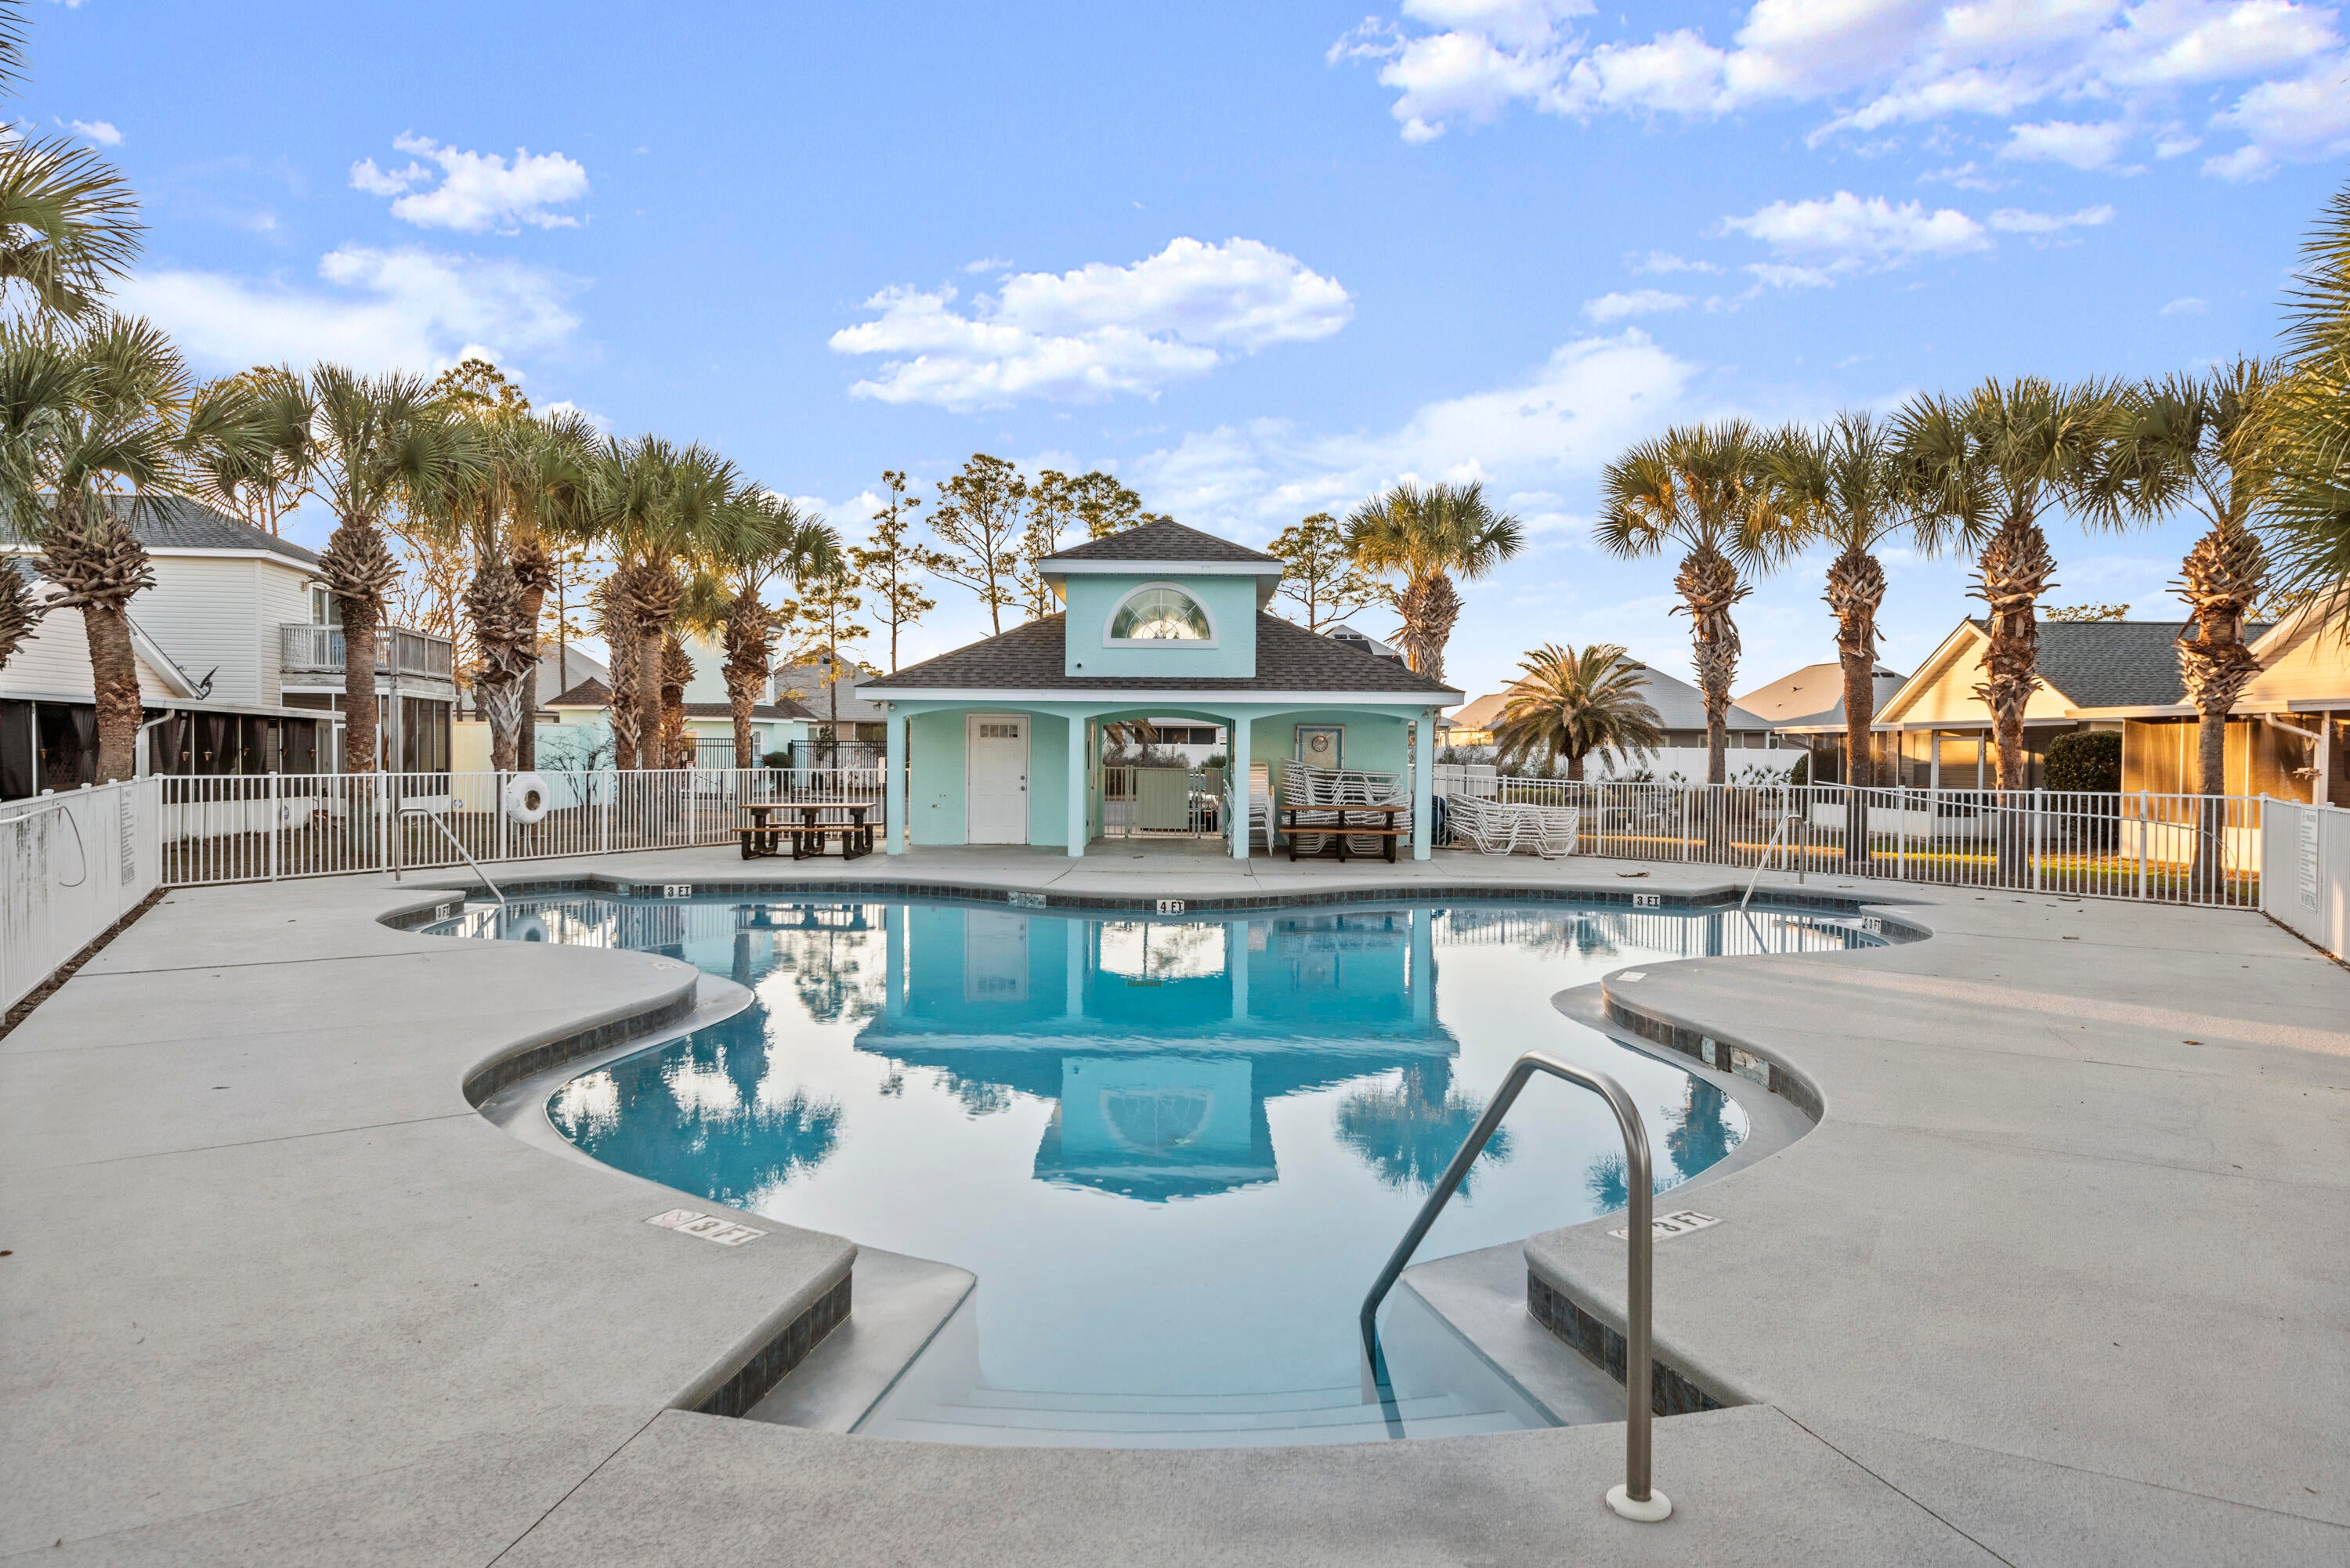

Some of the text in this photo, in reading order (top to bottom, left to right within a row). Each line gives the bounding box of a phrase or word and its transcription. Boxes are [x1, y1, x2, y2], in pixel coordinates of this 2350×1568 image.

[667, 886, 674, 897] 3
[1637, 895, 1643, 905] 3
[1160, 901, 1184, 913] 4 FT
[1874, 919, 1881, 931] FT
[1652, 1211, 1716, 1232] 3 FT
[689, 1220, 760, 1244] 3 FT
